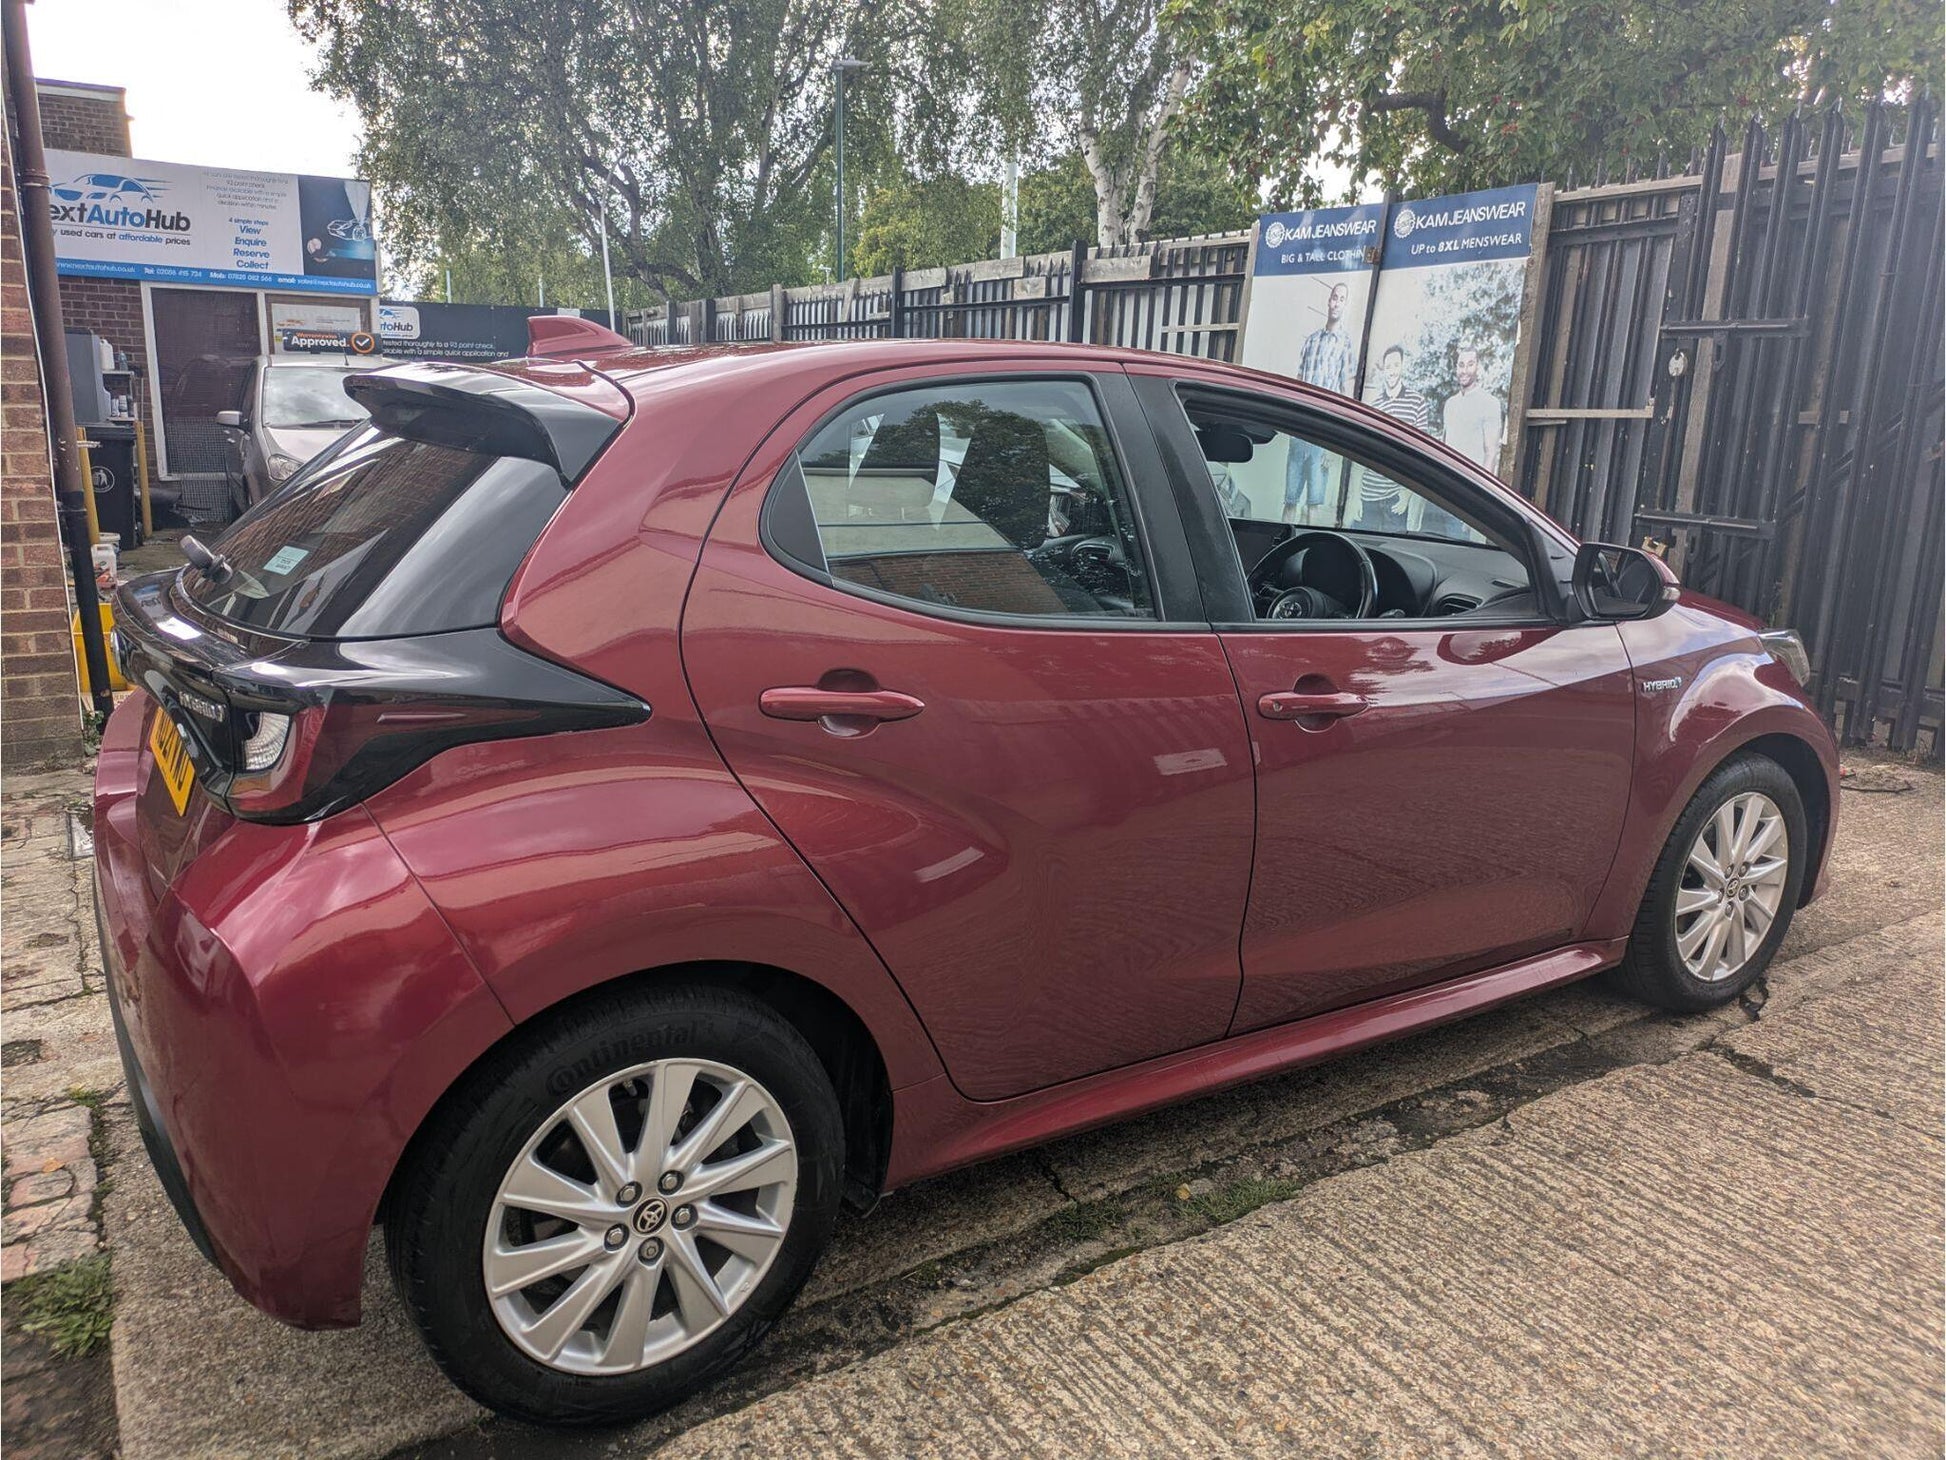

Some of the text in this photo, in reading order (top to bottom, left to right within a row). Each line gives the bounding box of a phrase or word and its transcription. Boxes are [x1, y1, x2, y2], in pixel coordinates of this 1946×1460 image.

[1415, 201, 1526, 230] KAM JEANSWEAR
[240, 225, 262, 235] View
[1284, 219, 1377, 241] KAM JEANSWEAR
[60, 228, 83, 237] used
[85, 231, 104, 239] cars
[107, 232, 116, 240] at
[118, 233, 163, 243] affordable
[165, 237, 191, 246] prices
[234, 236, 267, 247] Enquire
[1410, 233, 1522, 255] UP to 8XL MENSWEAR
[233, 248, 270, 259] Reserve
[1281, 251, 1295, 264] BIG
[1297, 252, 1303, 263] &
[1327, 247, 1366, 262] CLOTHIN
[236, 259, 269, 270] Collect
[291, 336, 350, 348] Approved.
[403, 340, 435, 349] thoroughly
[1643, 679, 1677, 692] HYBRID
